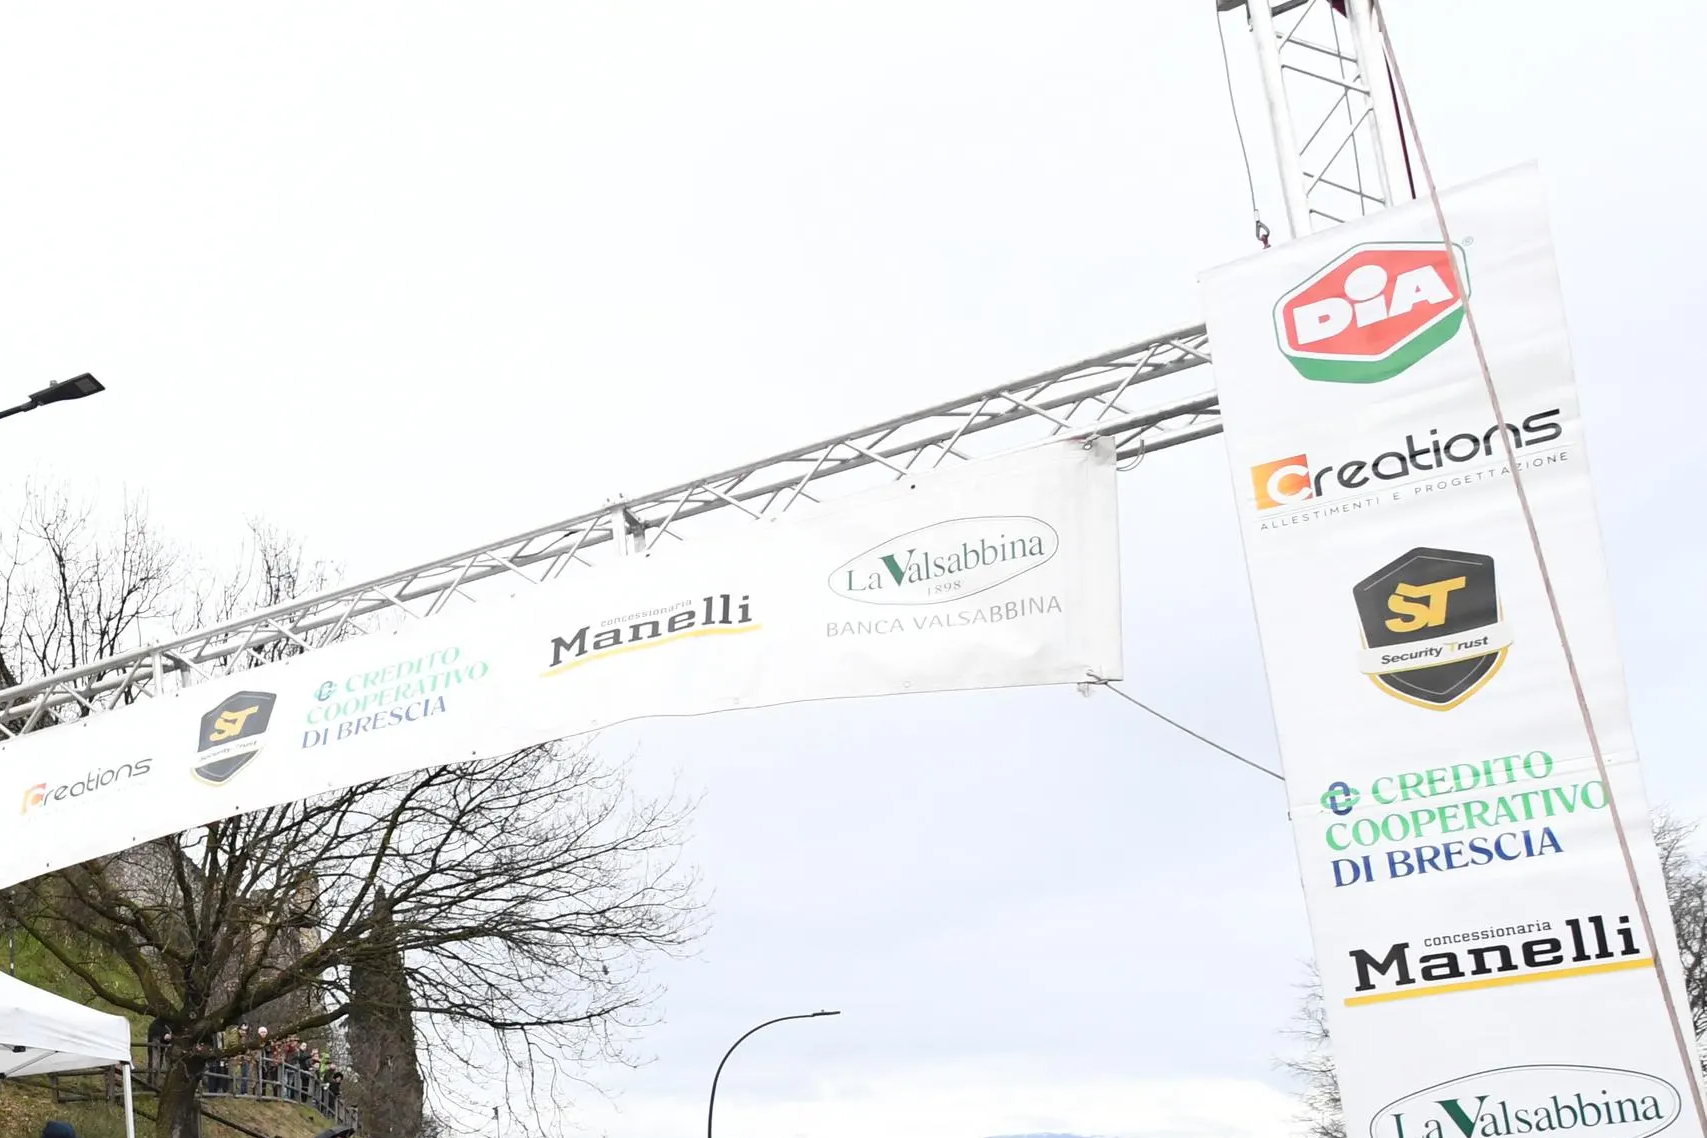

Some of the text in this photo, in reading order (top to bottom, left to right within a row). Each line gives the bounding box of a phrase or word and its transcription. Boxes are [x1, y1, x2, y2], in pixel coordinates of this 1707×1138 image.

[1251, 408, 1562, 510] Creations
[1261, 452, 1568, 531] ALLESTIMENTI E PROGETTAZIONE
[600, 598, 692, 627] concessionaria
[928, 579, 962, 597] 1898
[1384, 576, 1466, 633] ST
[549, 594, 752, 667] Manelli
[827, 595, 1062, 638] BANCA VALSABBINA
[345, 646, 461, 692] CREDITO
[1381, 644, 1443, 666] Security
[306, 661, 489, 725] COOPERATIVO
[301, 696, 446, 749] DI BRESCIA
[1371, 750, 1553, 805] CREDITO
[1325, 780, 1611, 851] COOPERATIVO
[1331, 826, 1564, 888] DI BRESCIA
[1349, 915, 1640, 992] Manelli
[1423, 920, 1552, 947] concessionaria
